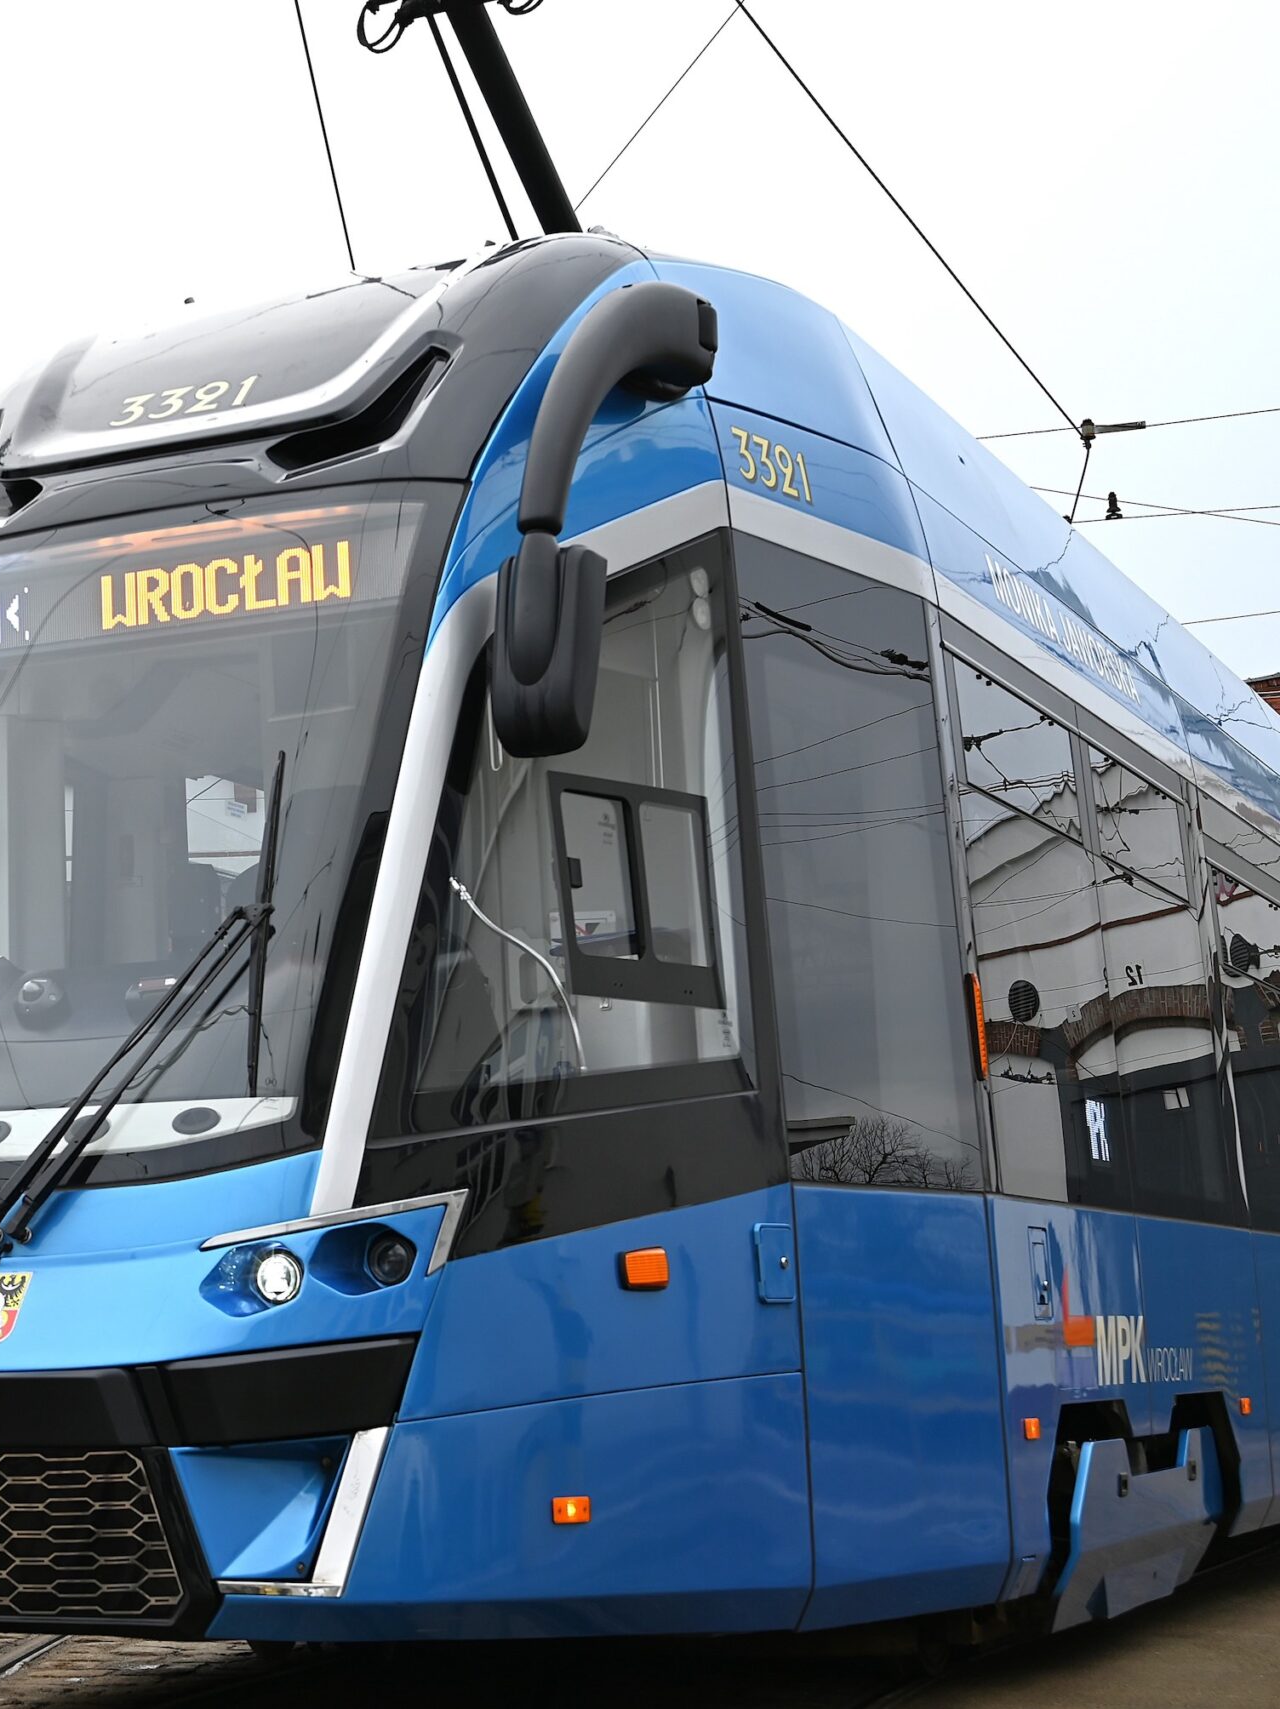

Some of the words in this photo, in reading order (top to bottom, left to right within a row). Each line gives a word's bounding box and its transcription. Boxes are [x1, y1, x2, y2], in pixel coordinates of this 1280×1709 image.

[109, 374, 258, 427] 3321
[730, 425, 812, 503] 3321
[100, 540, 351, 631] WROCŁAW
[984, 552, 1062, 646] MONIKA
[1058, 610, 1142, 706] JAWORSKA
[1095, 1315, 1147, 1386] MPK
